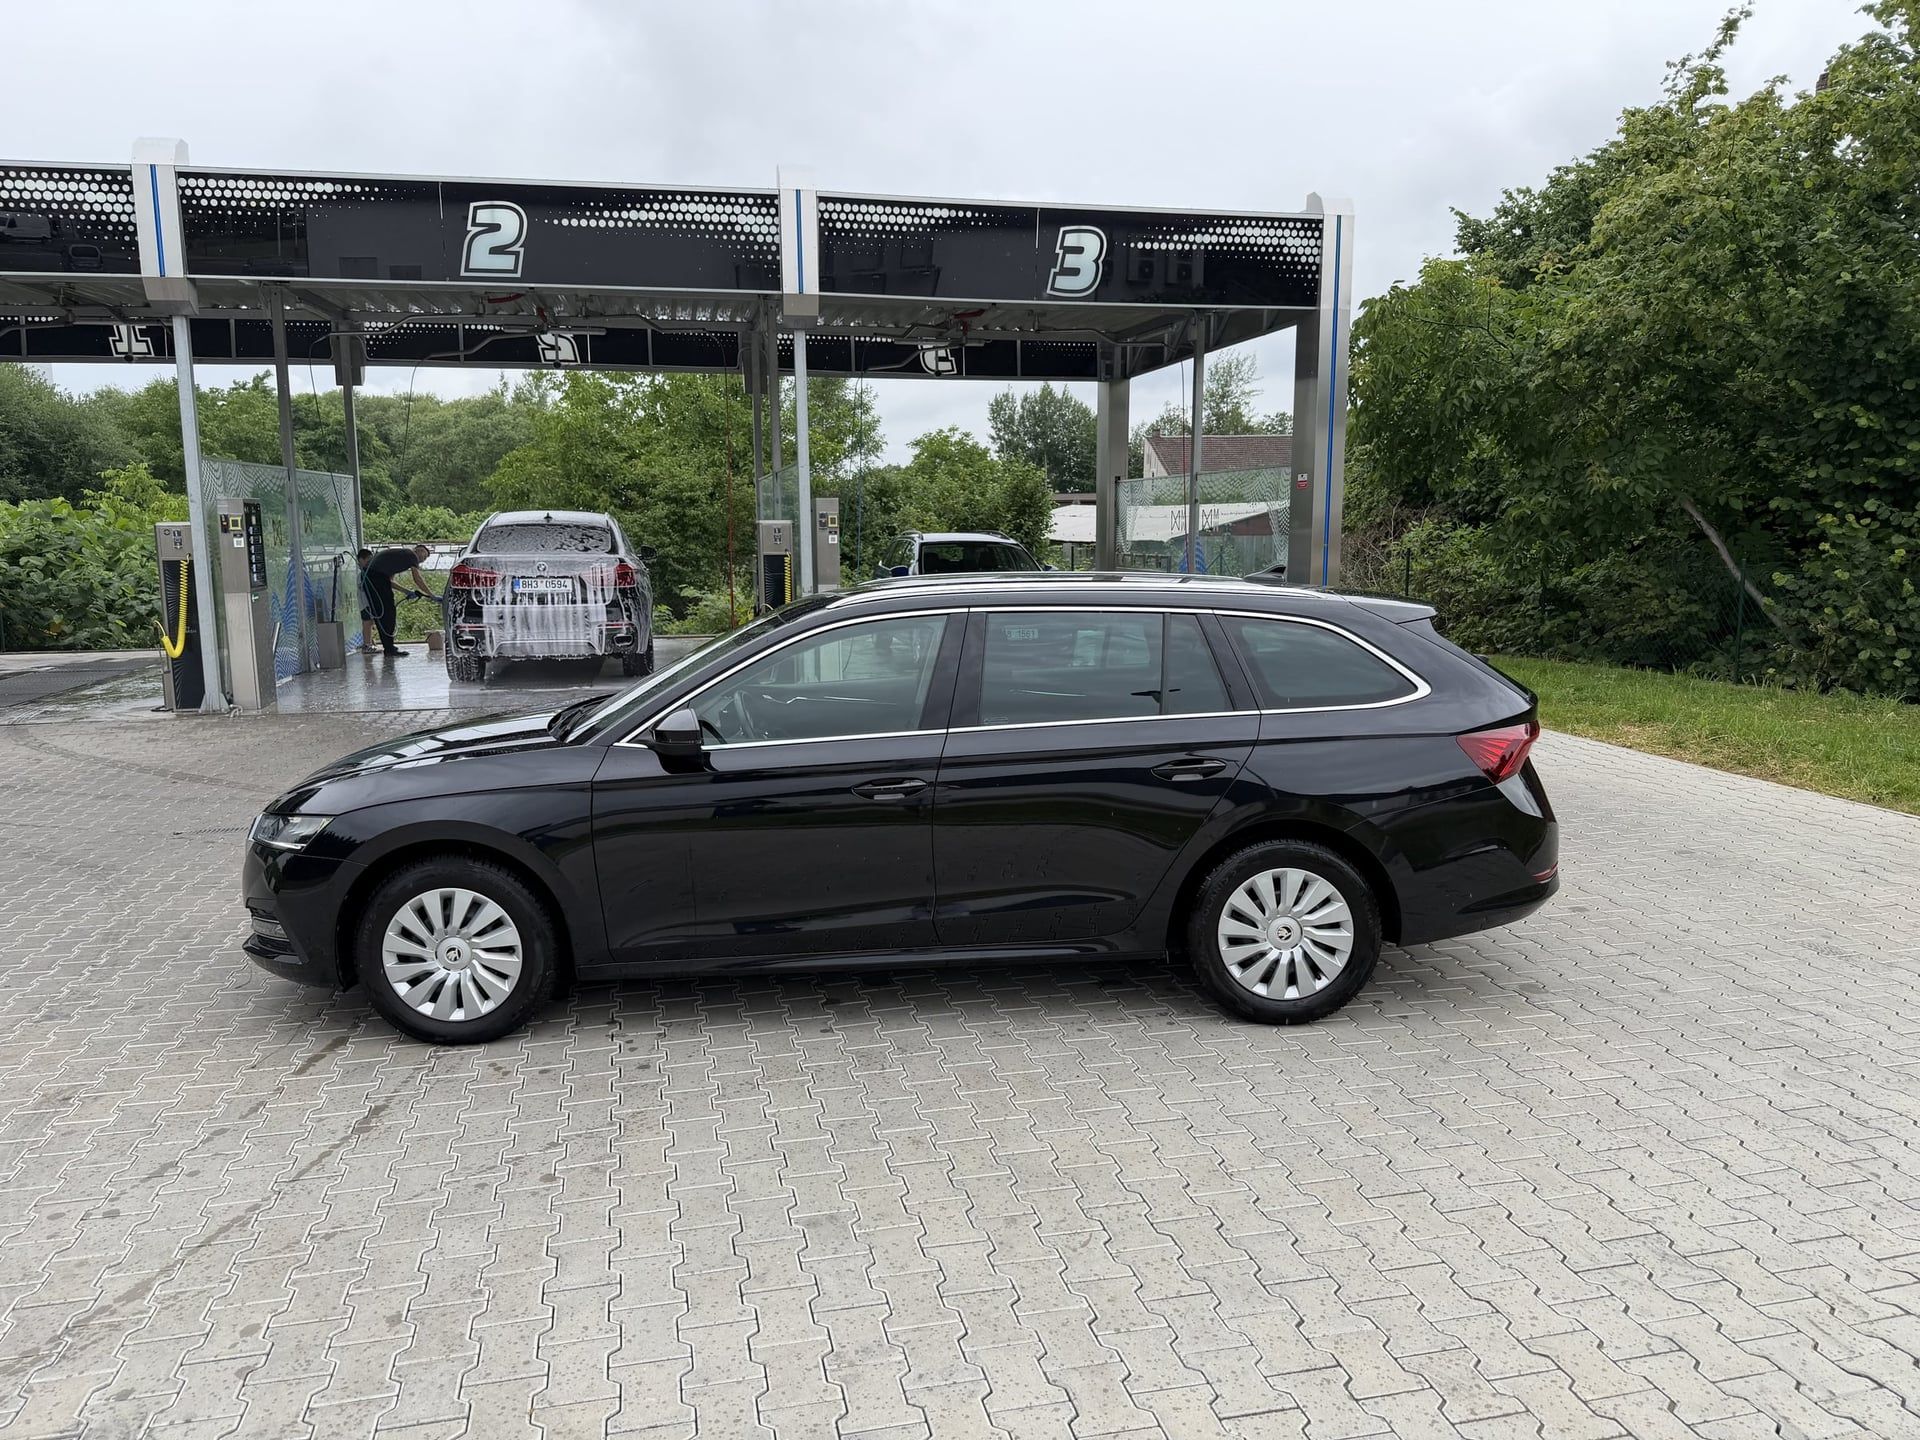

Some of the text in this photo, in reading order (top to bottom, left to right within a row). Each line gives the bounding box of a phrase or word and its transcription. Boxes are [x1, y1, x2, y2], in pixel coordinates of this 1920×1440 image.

[460, 200, 528, 278] 2
[1046, 225, 1107, 297] 3
[521, 580, 568, 589] 8H3 0594
